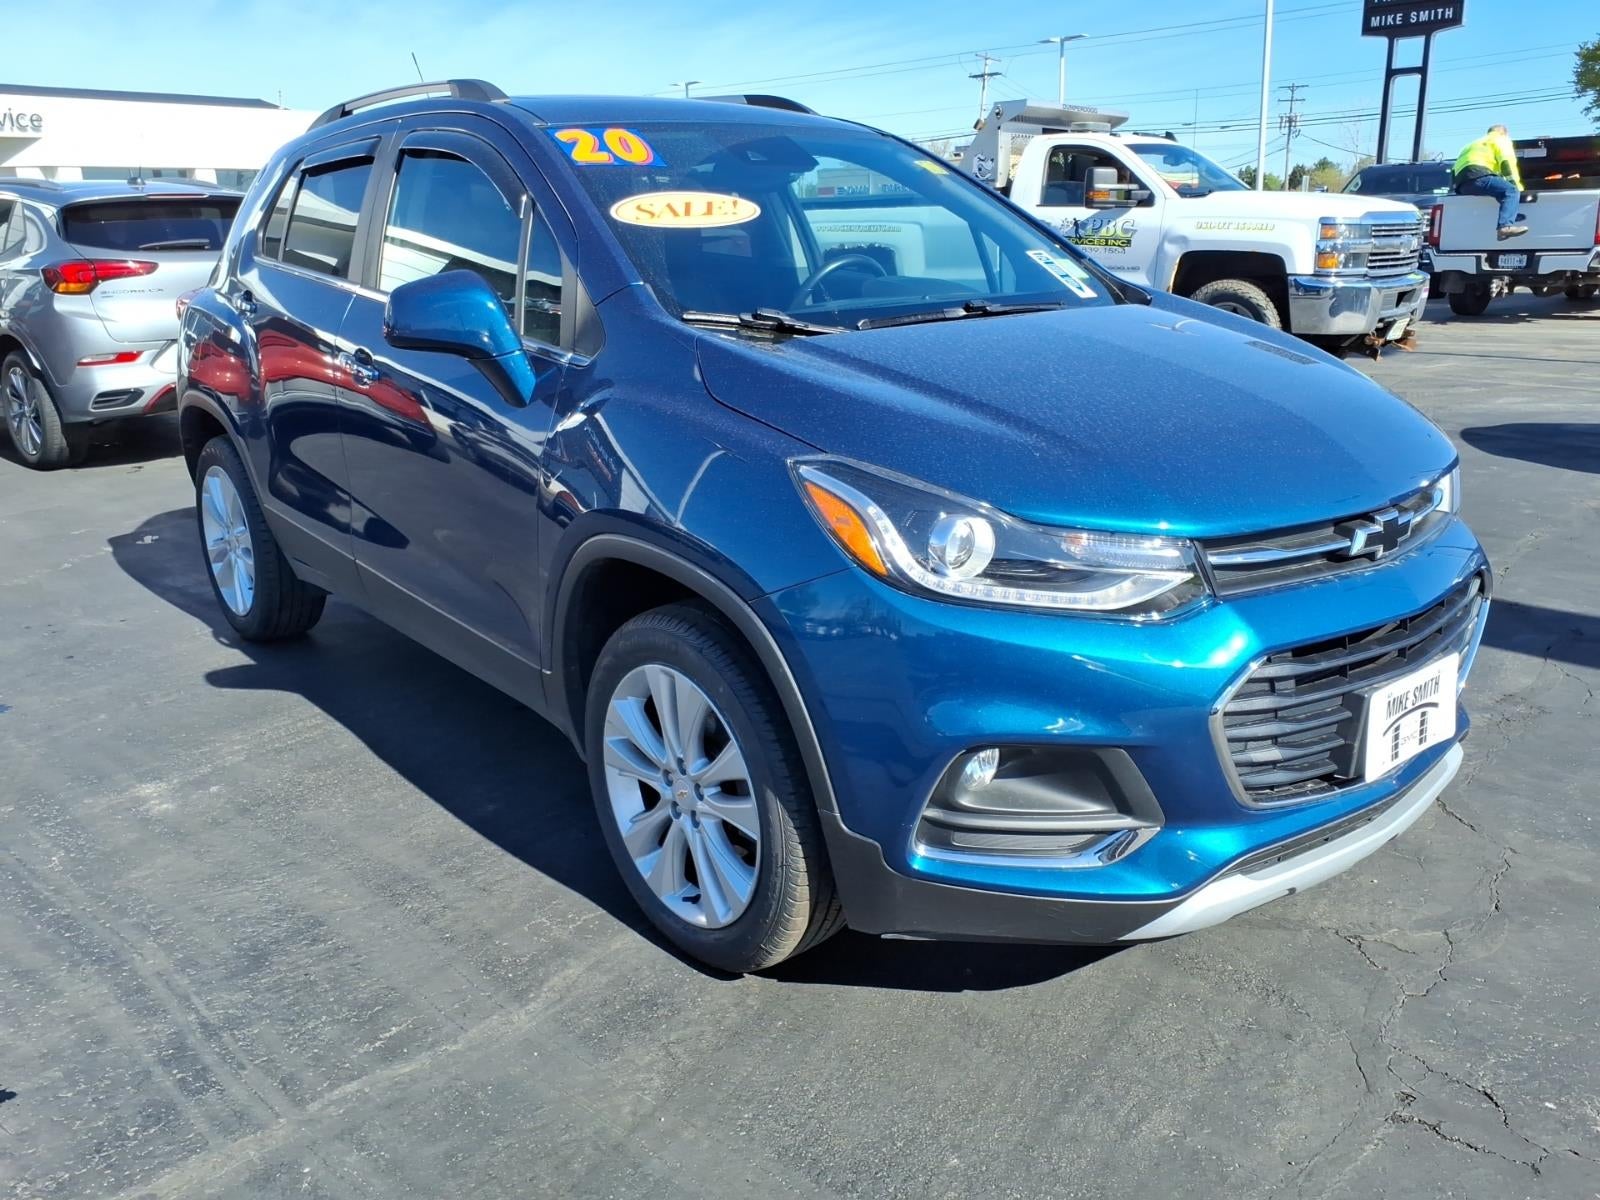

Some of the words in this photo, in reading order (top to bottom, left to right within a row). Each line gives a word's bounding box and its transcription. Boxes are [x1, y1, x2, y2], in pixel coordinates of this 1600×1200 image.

[1371, 13, 1403, 27] MIKE
[1410, 8, 1454, 23] SMITH
[555, 128, 655, 164] 20
[635, 200, 739, 220] SALE!
[1108, 239, 1130, 247] INC.
[1386, 690, 1411, 720] MIKE
[1412, 674, 1440, 707] SMITH
